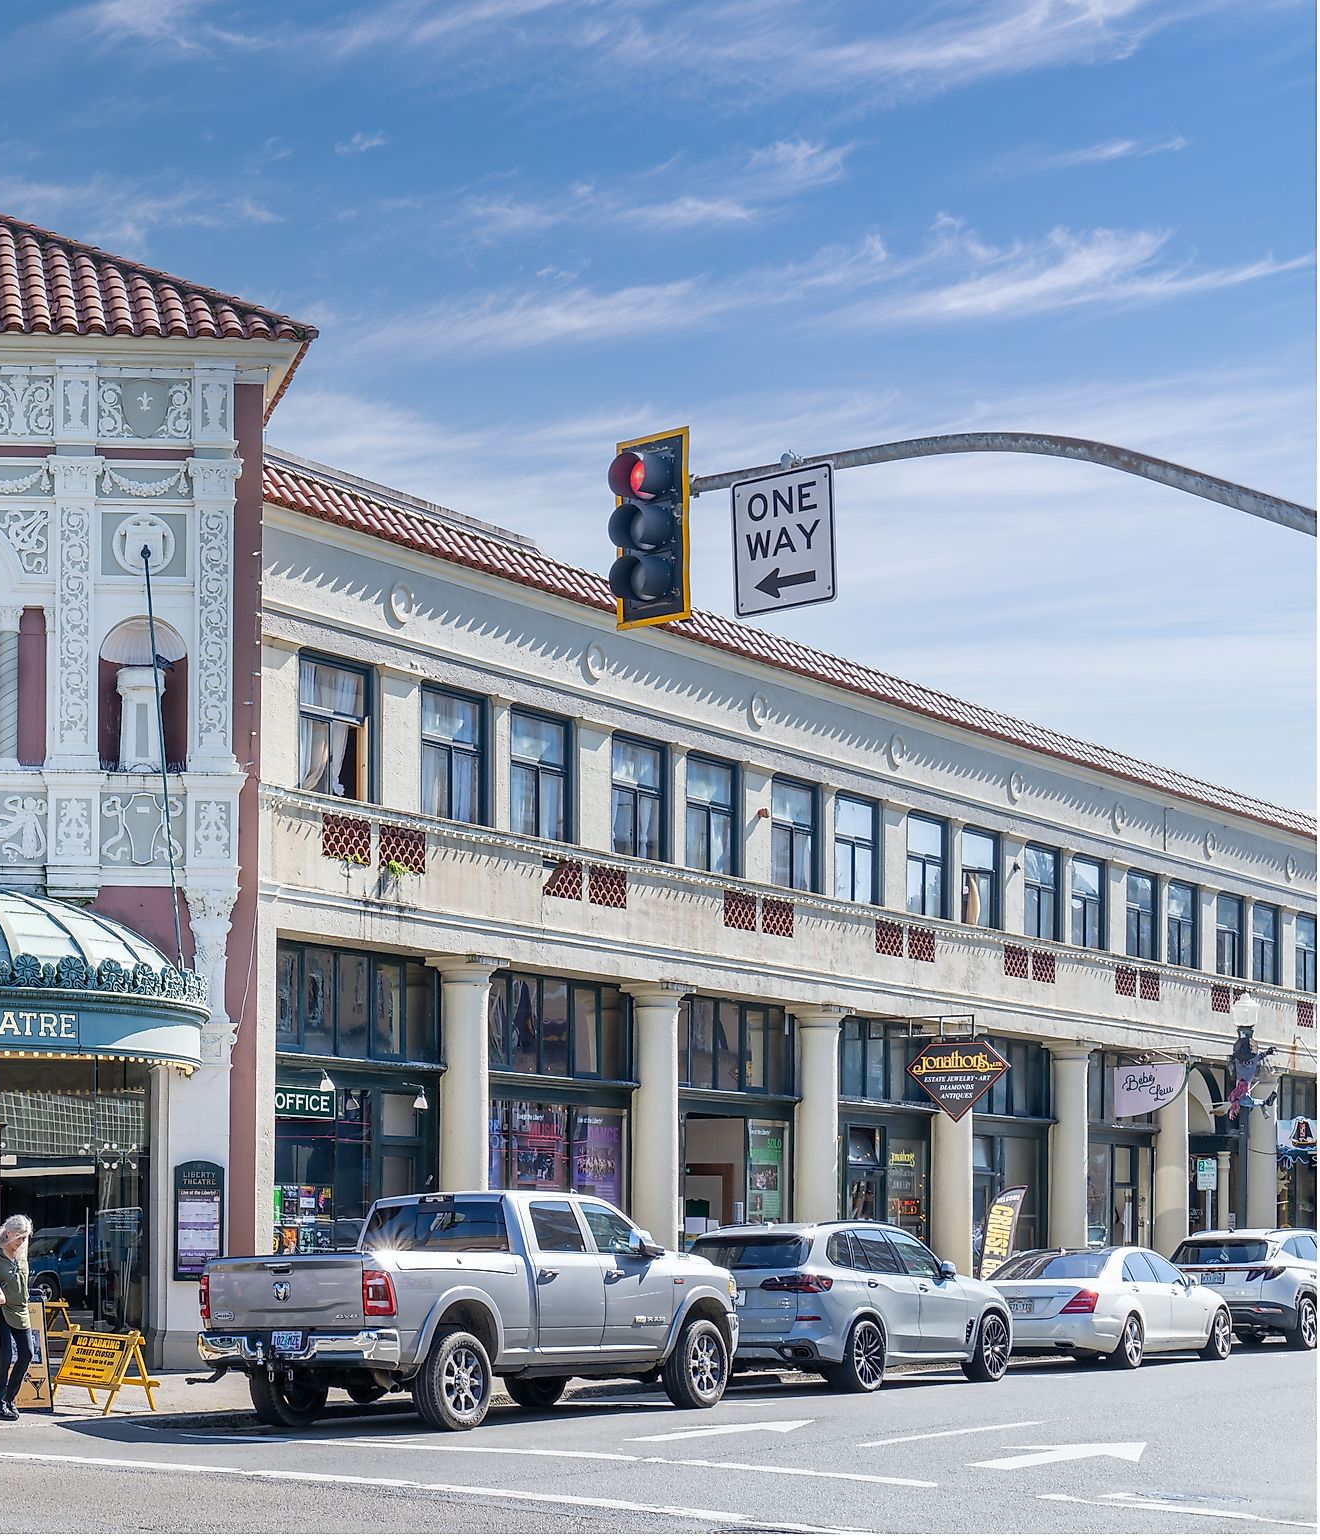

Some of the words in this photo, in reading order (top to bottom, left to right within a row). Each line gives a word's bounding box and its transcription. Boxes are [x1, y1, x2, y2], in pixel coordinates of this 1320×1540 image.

[747, 480, 818, 522] ONE
[745, 518, 822, 562] WAY
[923, 1075, 946, 1083] ESTATE
[275, 1092, 330, 1113] OFFICE
[940, 1092, 974, 1100] ANTIQUES
[589, 1126, 619, 1141] DANCE
[767, 1138, 782, 1149] SOLO
[983, 1204, 1015, 1258] CRUISE
[77, 1336, 88, 1346] NO
[88, 1337, 121, 1350] PARKING
[76, 1347, 95, 1357] STREET
[95, 1349, 116, 1359] CLOSED
